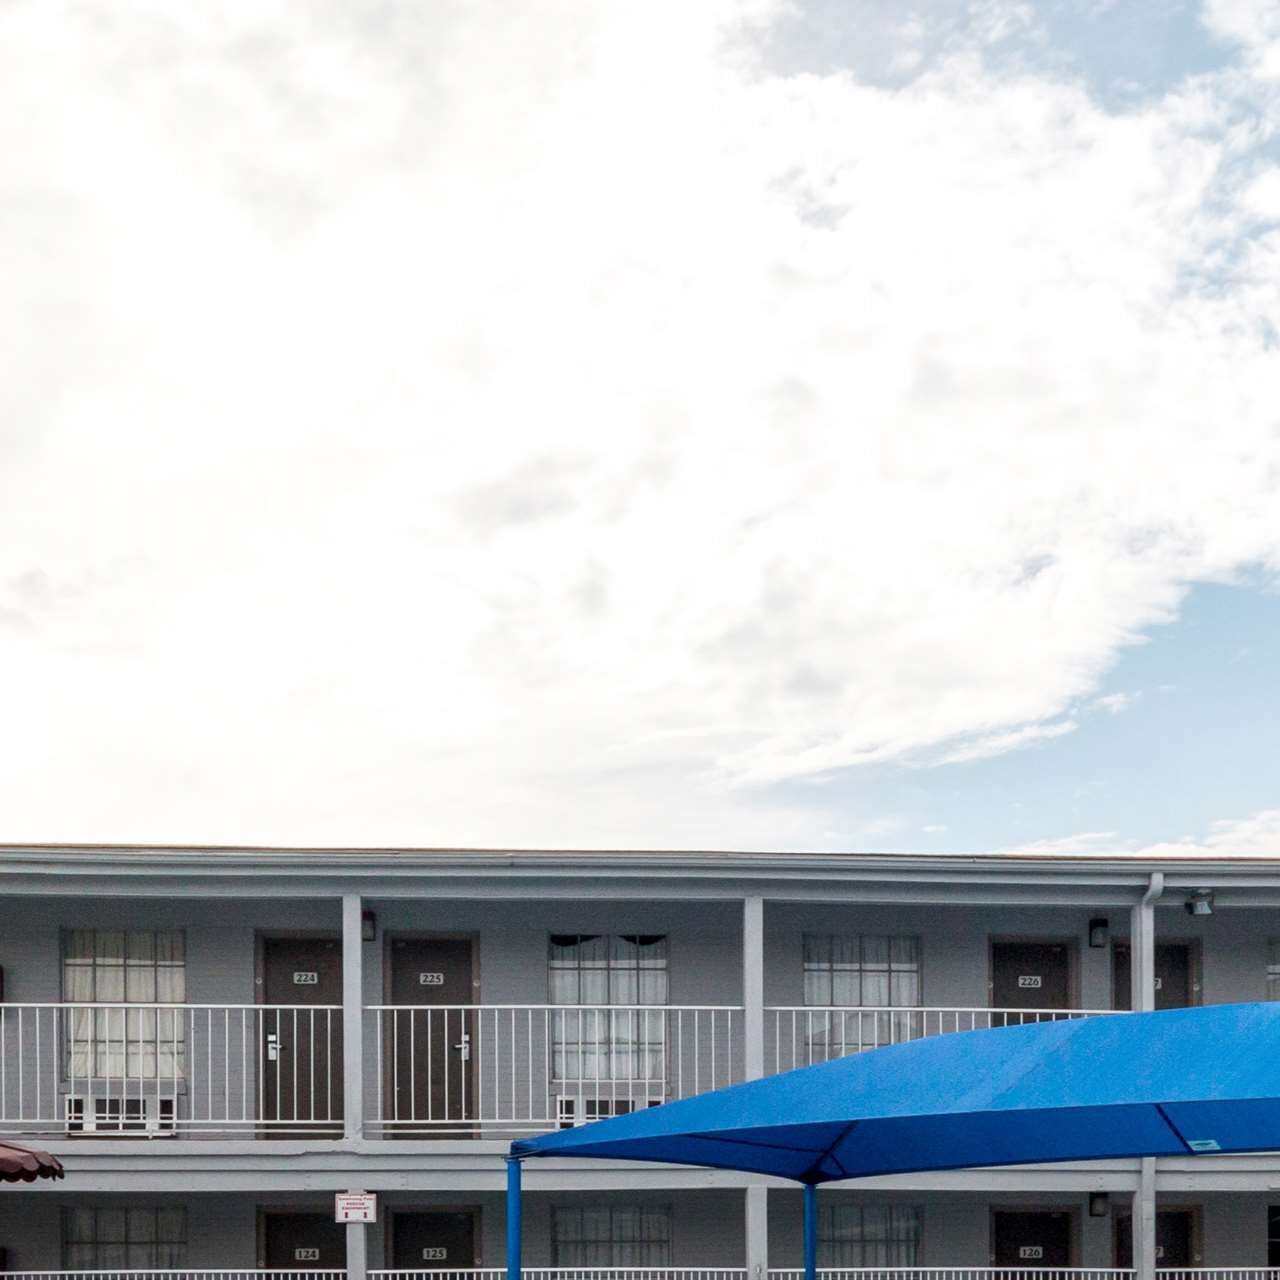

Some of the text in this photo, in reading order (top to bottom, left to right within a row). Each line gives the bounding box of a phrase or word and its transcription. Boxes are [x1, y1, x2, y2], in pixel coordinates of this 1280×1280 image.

[295, 973, 317, 983] 224
[422, 974, 441, 984] 225
[1020, 977, 1040, 987] 226
[296, 1249, 317, 1260] 124
[424, 1249, 445, 1259] 125
[1022, 1247, 1040, 1258] 126
